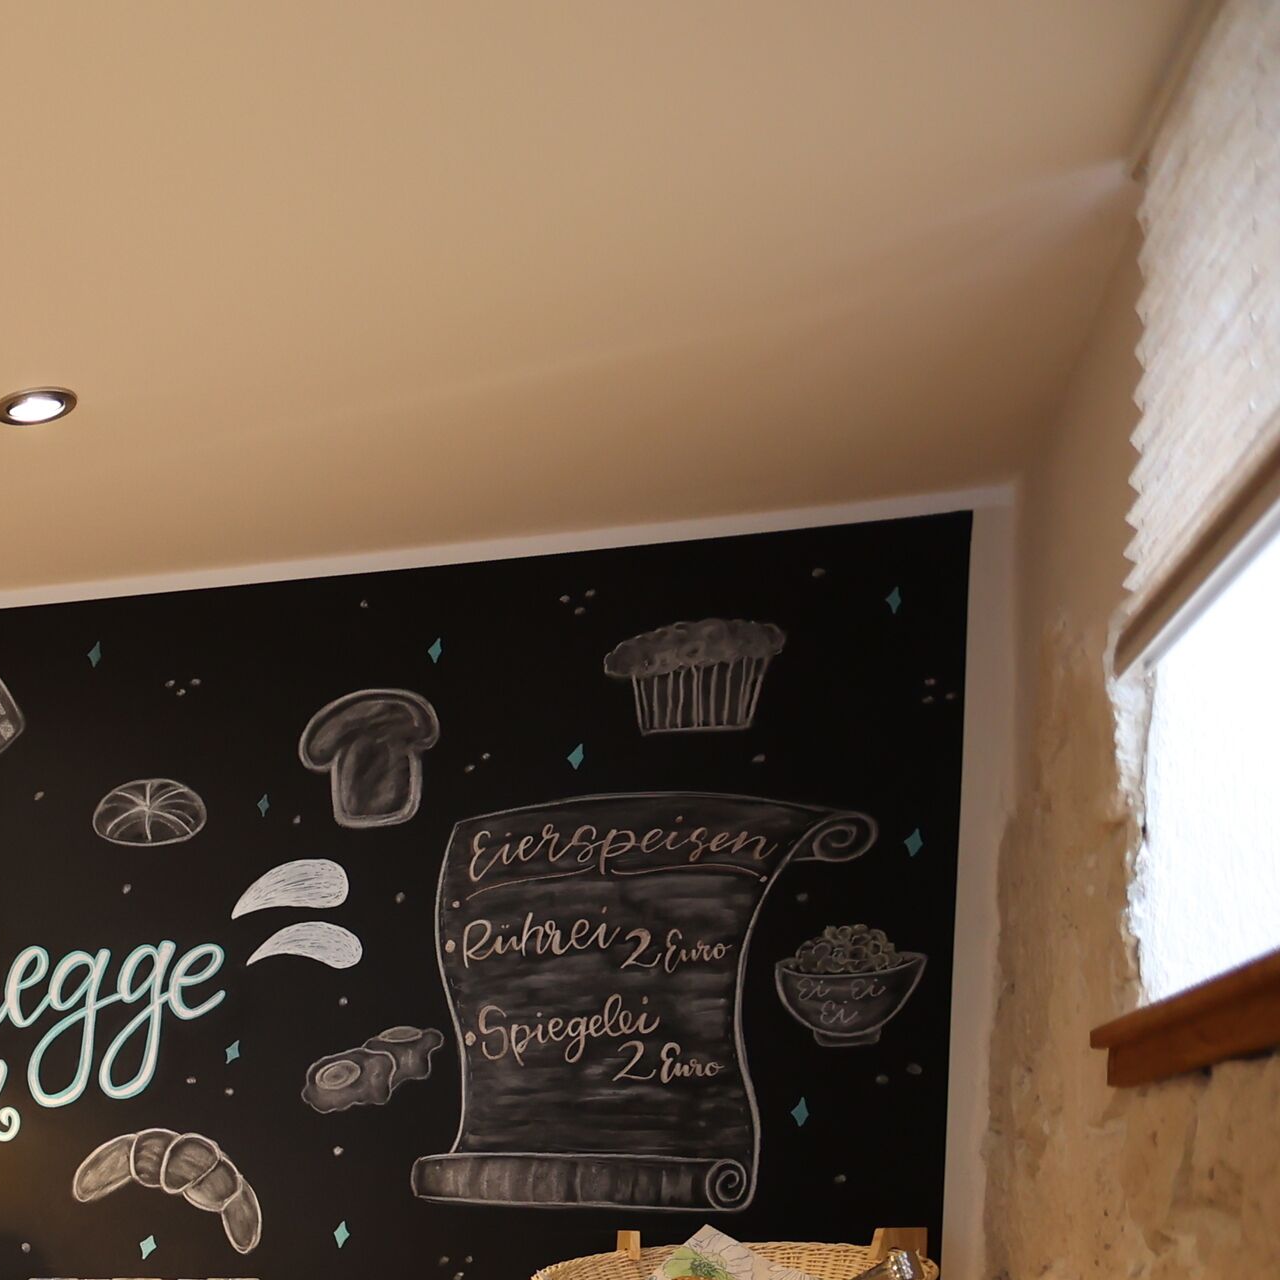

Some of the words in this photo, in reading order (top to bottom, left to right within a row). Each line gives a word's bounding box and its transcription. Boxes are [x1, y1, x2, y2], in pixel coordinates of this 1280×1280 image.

[469, 816, 778, 882] Eierspeisen
[463, 906, 621, 968] Rührei
[620, 928, 663, 969] 2
[664, 929, 732, 973] Euro
[797, 978, 831, 1000] Ei
[850, 978, 886, 1000] Ei
[820, 1000, 858, 1024] Ei
[478, 994, 660, 1066] Spiegelei
[612, 1041, 657, 1082] 2
[660, 1042, 725, 1084] Euro
